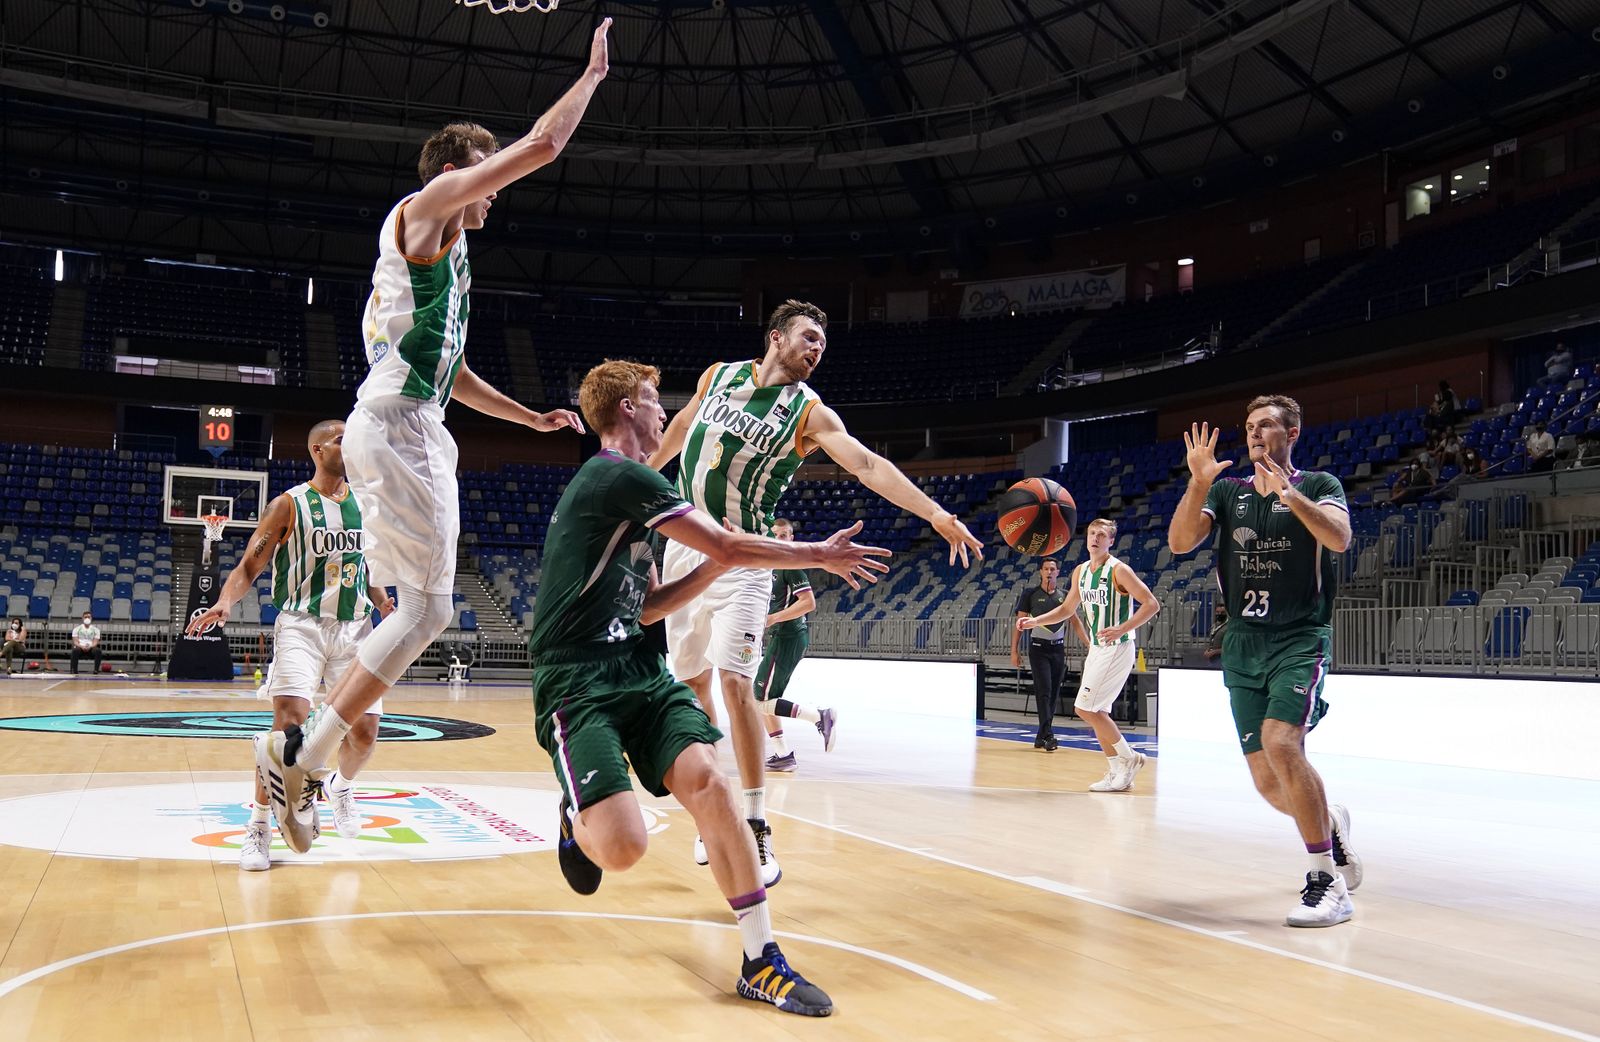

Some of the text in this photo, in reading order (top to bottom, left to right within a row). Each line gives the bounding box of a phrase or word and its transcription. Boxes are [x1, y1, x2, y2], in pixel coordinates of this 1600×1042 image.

[1028, 277, 1113, 302] MÁLAGA
[205, 422, 231, 441] 10
[702, 395, 775, 451] COOSUR
[708, 441, 724, 470] 3
[1256, 536, 1292, 549] Unicaja
[325, 562, 358, 588] 33
[1241, 589, 1270, 617] 23
